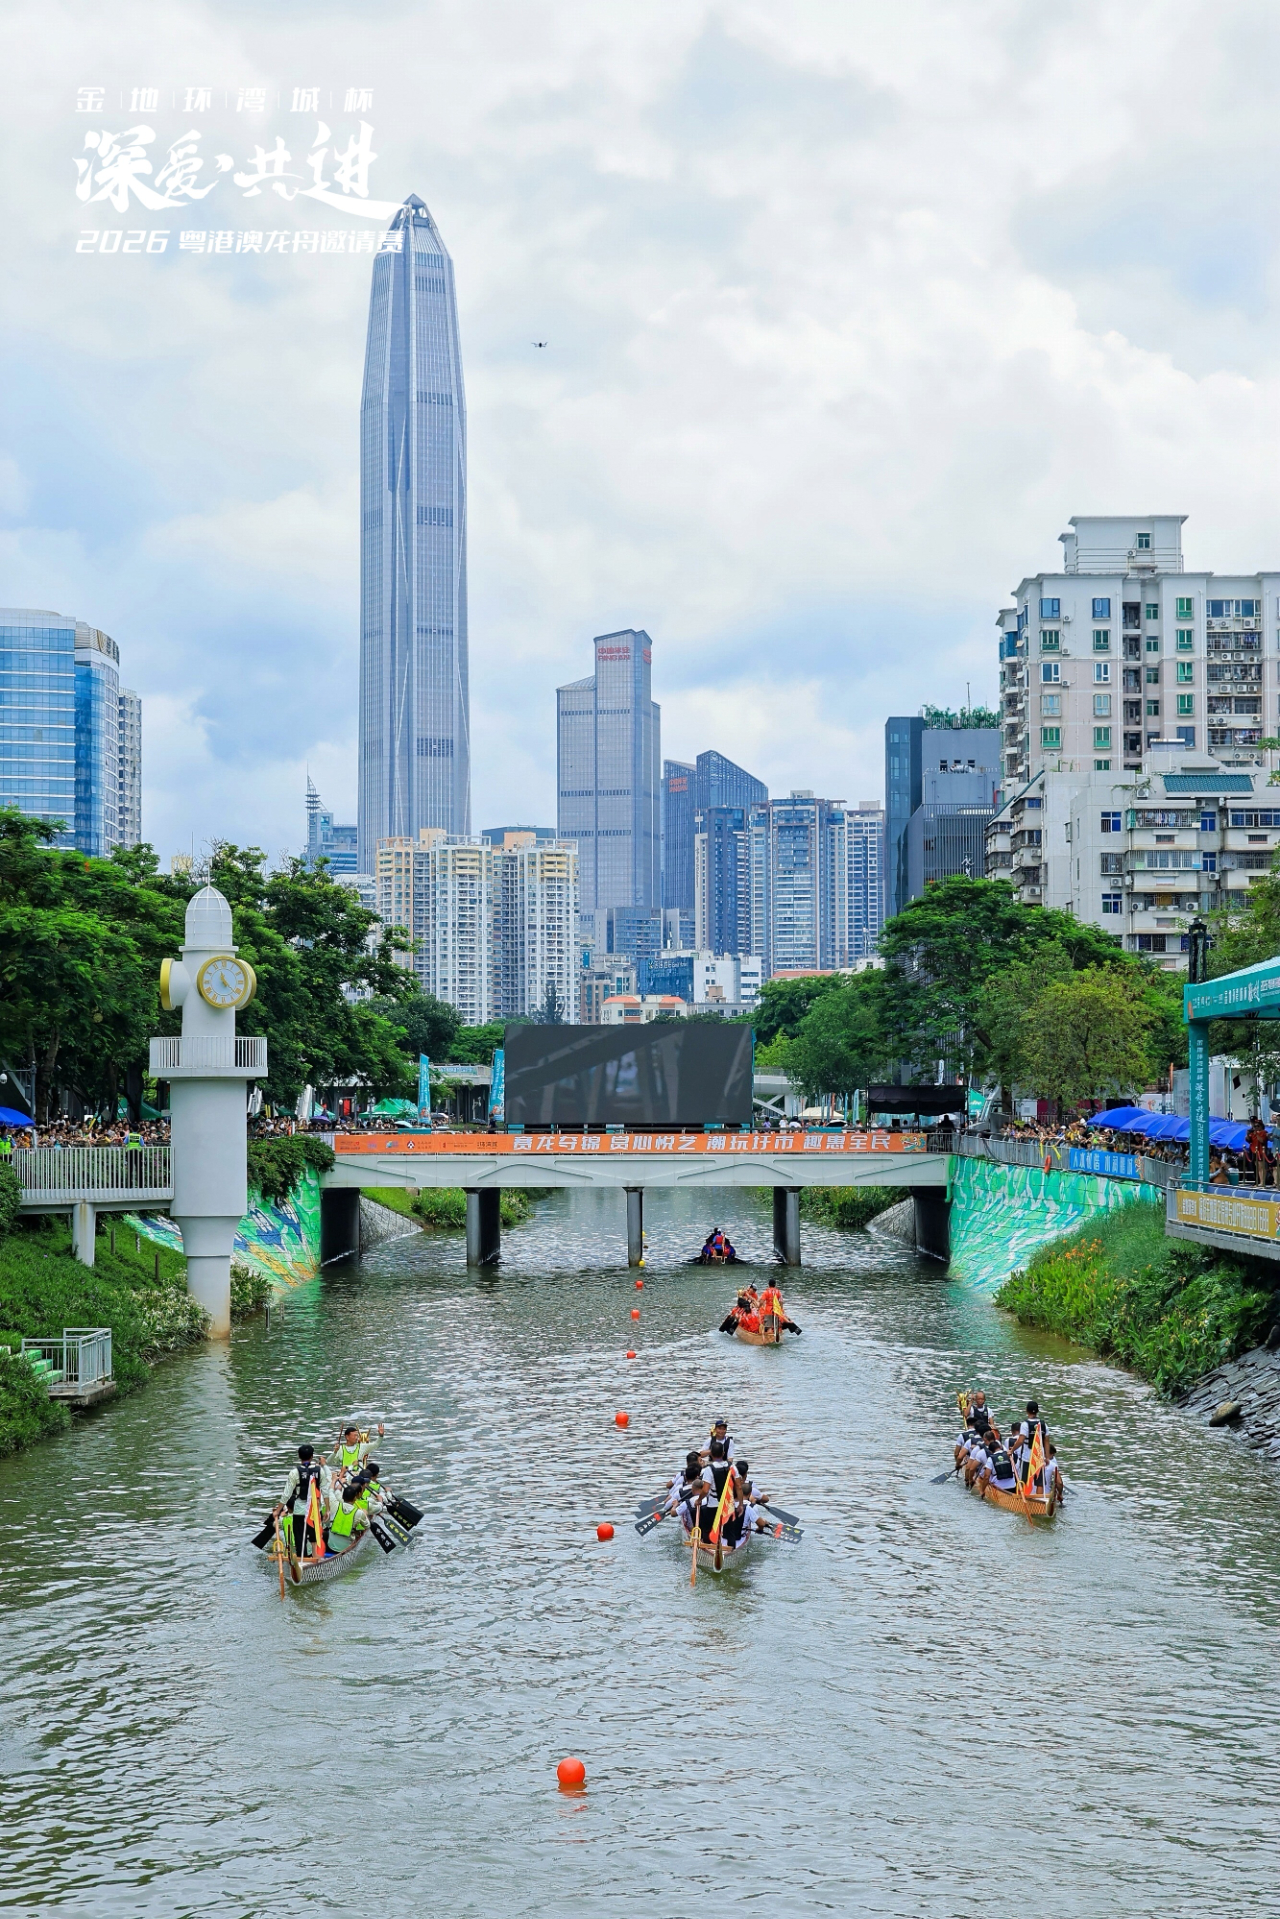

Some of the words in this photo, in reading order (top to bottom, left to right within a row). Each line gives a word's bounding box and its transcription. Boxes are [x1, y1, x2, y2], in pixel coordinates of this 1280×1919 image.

[513, 1135, 600, 1151] 赛龙夺锦
[609, 1135, 697, 1151] 赏心悦艺
[706, 1135, 794, 1150] 潮玩圩市
[802, 1134, 890, 1150] 趣惠全民
